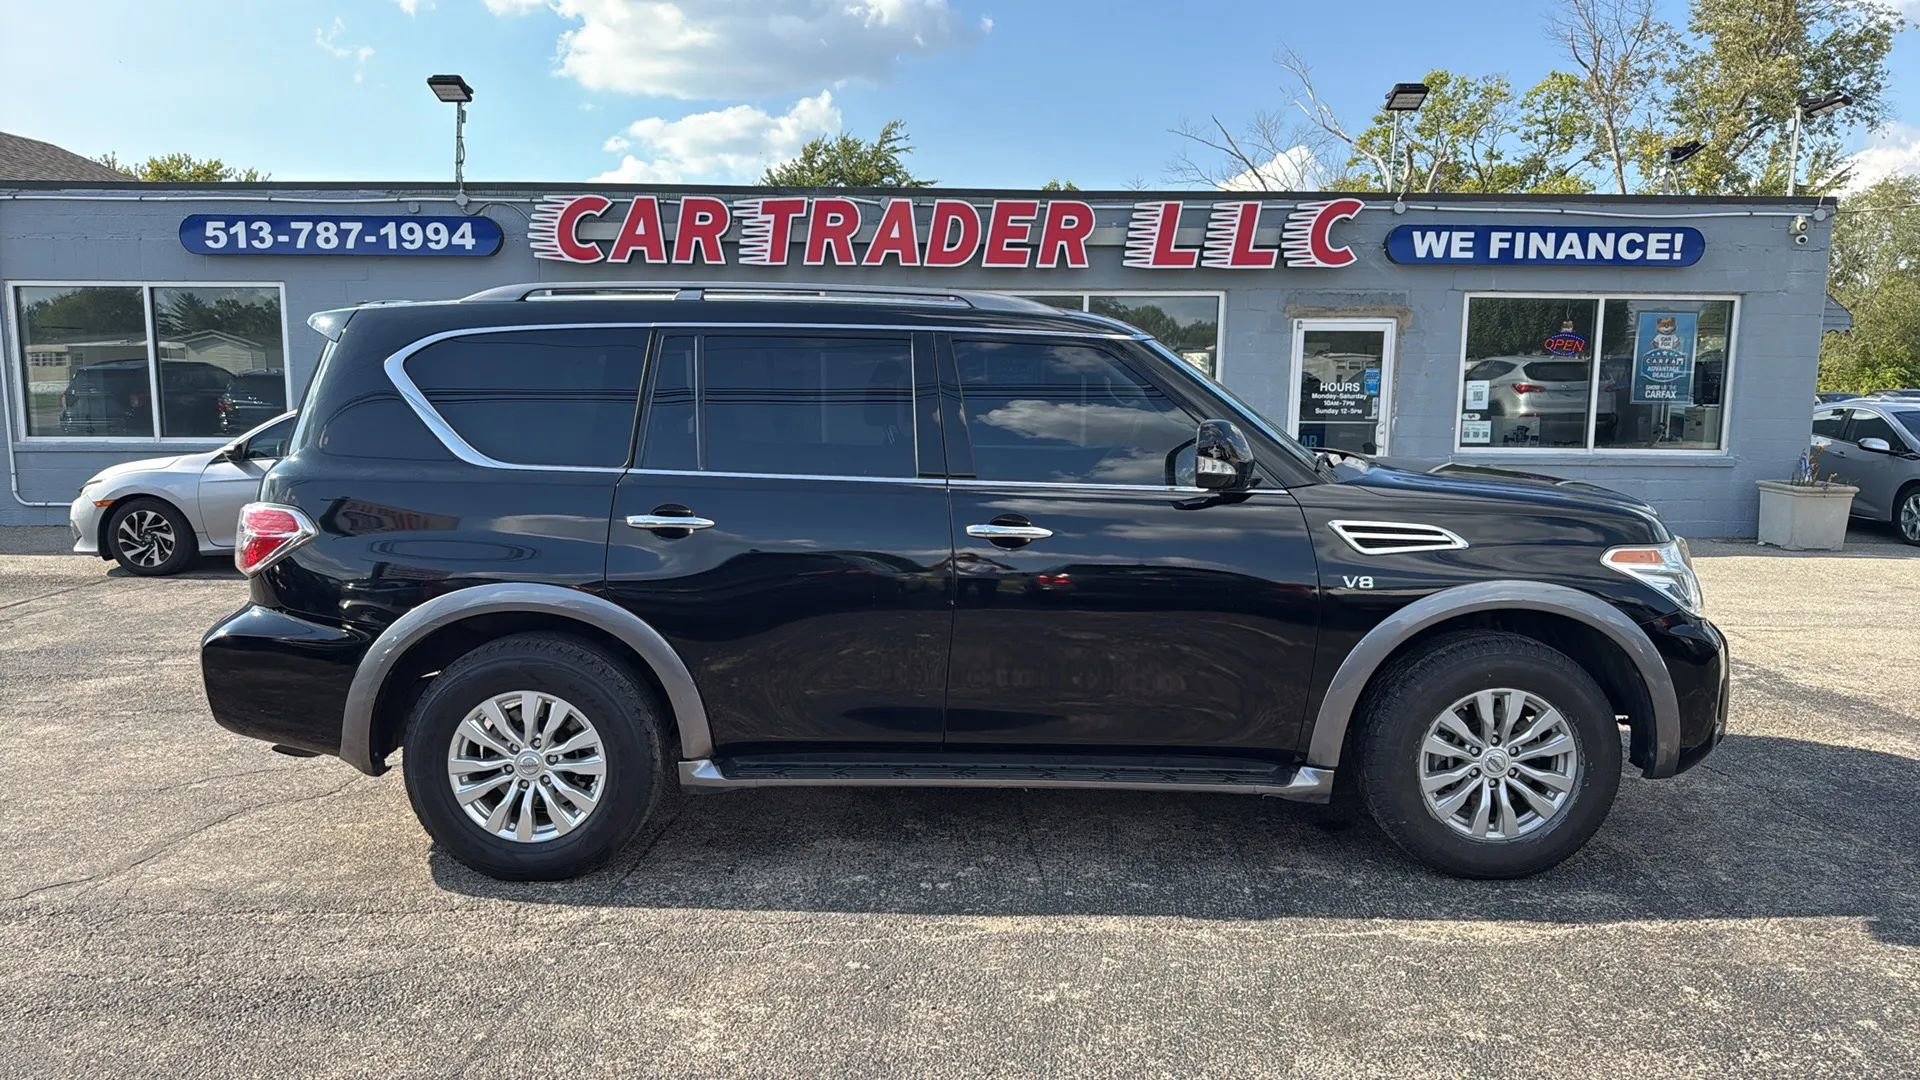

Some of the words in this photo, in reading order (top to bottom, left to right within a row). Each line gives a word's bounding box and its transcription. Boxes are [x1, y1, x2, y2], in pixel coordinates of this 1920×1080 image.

[204, 220, 476, 250] 513-787-1994
[1122, 198, 1366, 269] LLC
[1412, 231, 1475, 259] WE
[1489, 232, 1684, 260] FINANCE!
[1545, 338, 1585, 352] OPEN
[1320, 382, 1360, 392] HOURS
[1314, 407, 1340, 416] Sunday
[1342, 575, 1374, 589] V8
